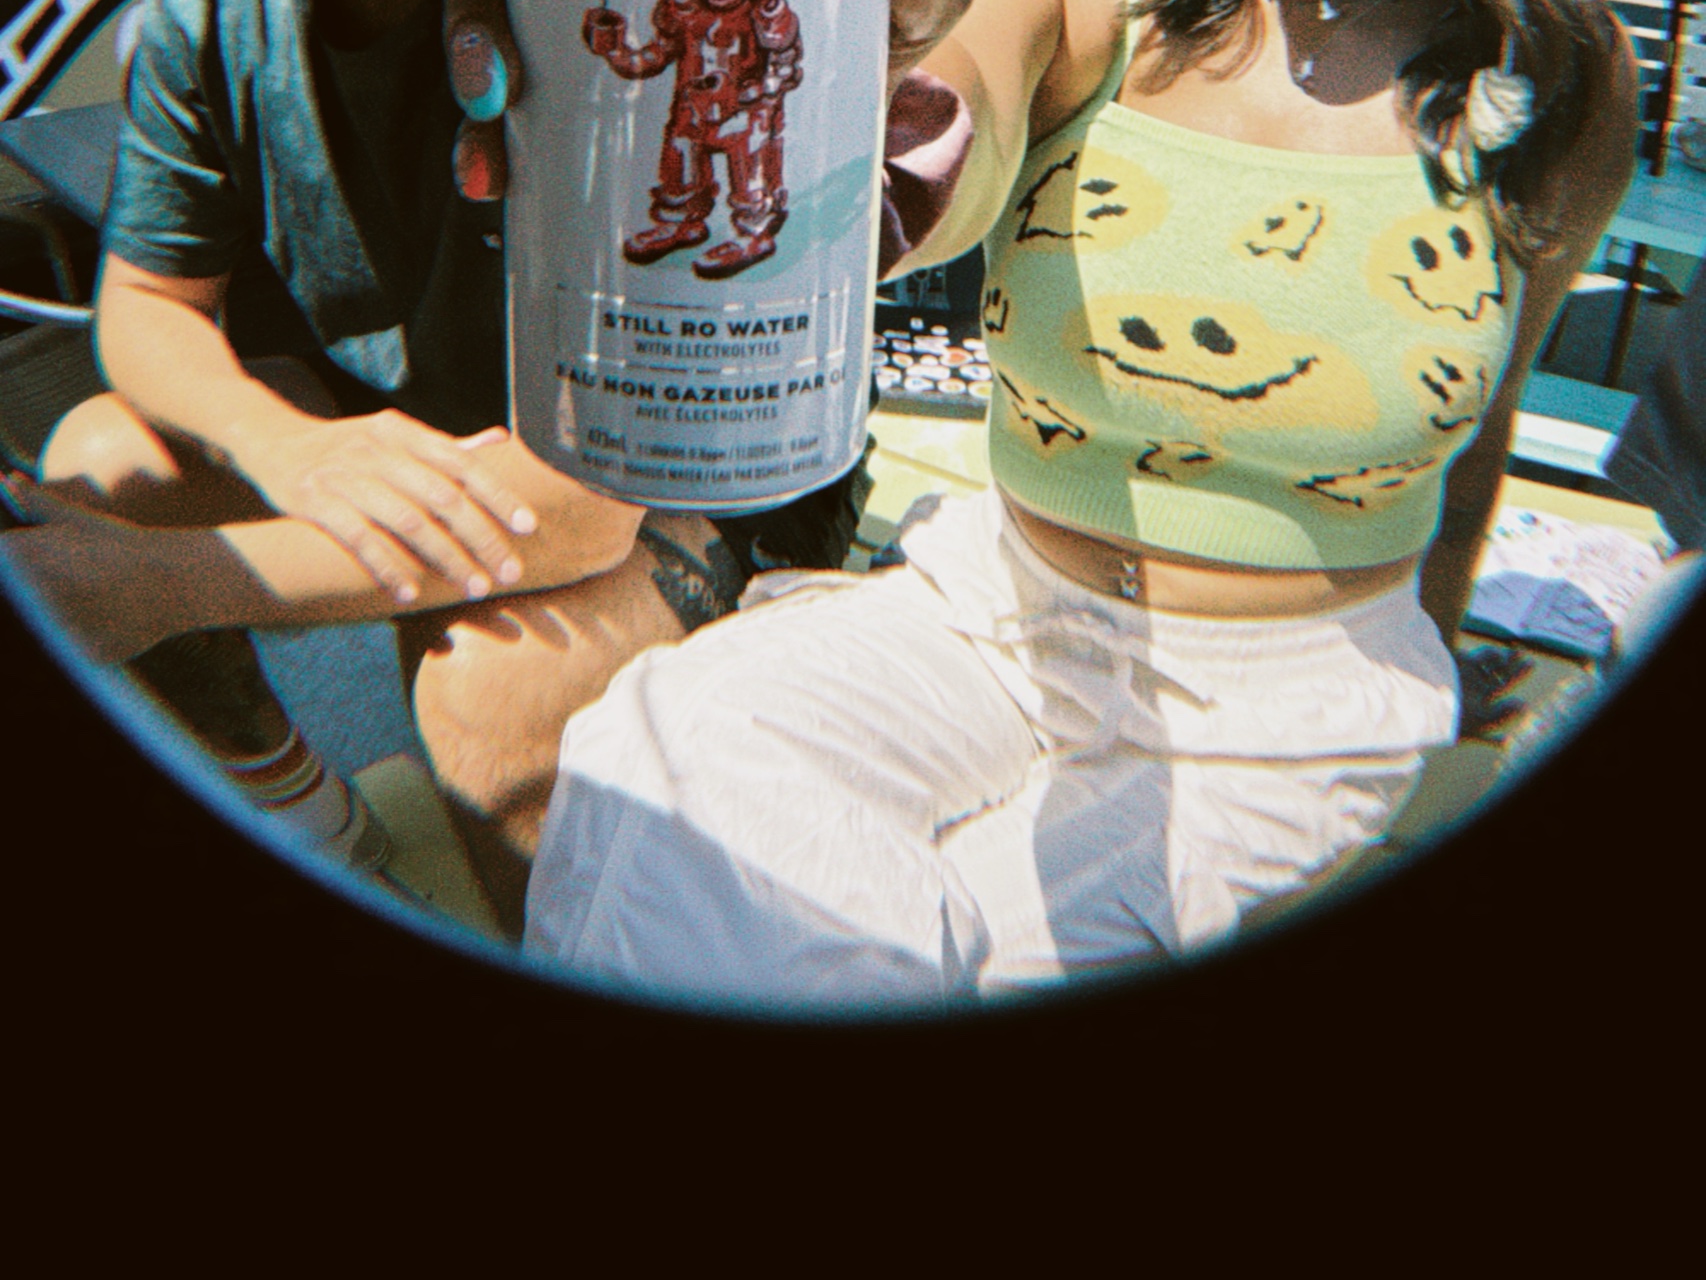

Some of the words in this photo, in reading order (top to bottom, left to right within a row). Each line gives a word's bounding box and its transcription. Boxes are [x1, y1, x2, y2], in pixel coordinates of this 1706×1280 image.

[603, 311, 672, 336] STILL
[680, 320, 716, 338] RO
[726, 314, 809, 337] WATER
[635, 339, 671, 357] WITH
[603, 377, 655, 400] NON
[664, 384, 779, 403] GAZEUSE
[787, 373, 825, 397] PAR
